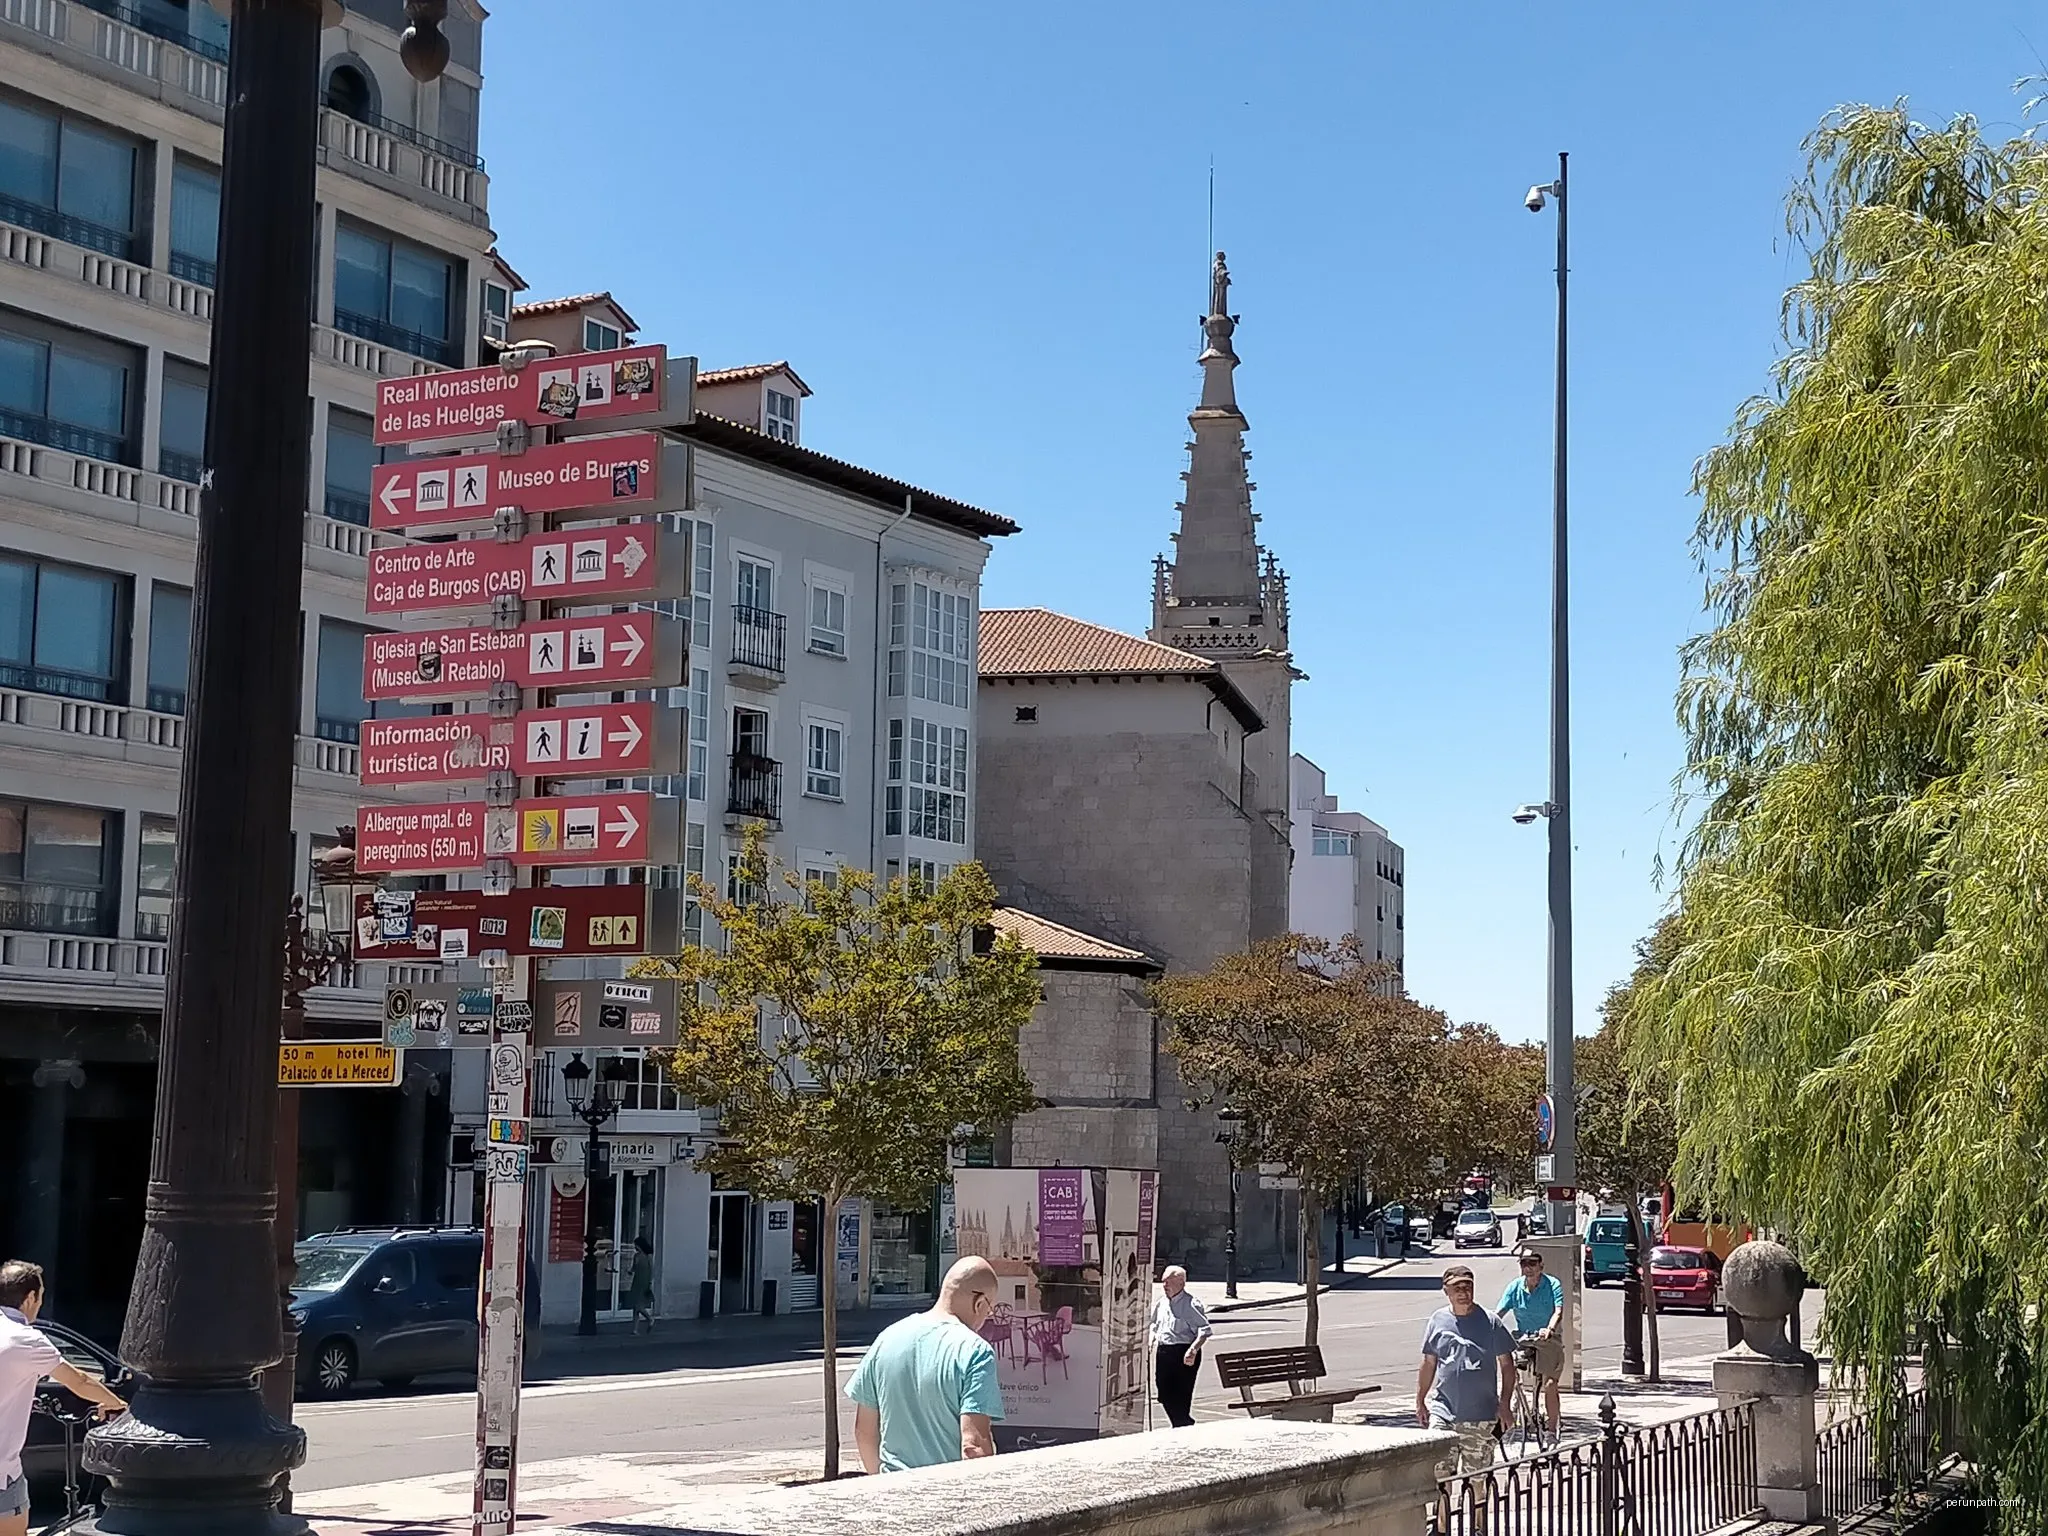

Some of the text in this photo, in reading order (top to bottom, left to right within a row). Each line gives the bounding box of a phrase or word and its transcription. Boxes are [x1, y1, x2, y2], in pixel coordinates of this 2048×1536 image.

[383, 373, 519, 405] Real Monasterio
[382, 404, 505, 432] de las Huelgas
[498, 468, 554, 490] Museo
[559, 463, 581, 481] de
[375, 548, 475, 574] Centro de Arte
[374, 569, 526, 605] Caja de Burgos (CAB)
[372, 631, 525, 664] Iglesia de San Esteban
[448, 659, 505, 683] Retablo)
[370, 721, 471, 746] Información
[369, 752, 438, 774] turística
[364, 807, 472, 835] Albergue mpal. de
[363, 836, 479, 864] peregrinos (550 m.)
[283, 1048, 299, 1060] 50
[305, 1050, 314, 1060] m
[337, 1047, 369, 1059] hotel
[280, 1063, 390, 1080] Palacio de La Merced
[1048, 1186, 1073, 1199] CAB
